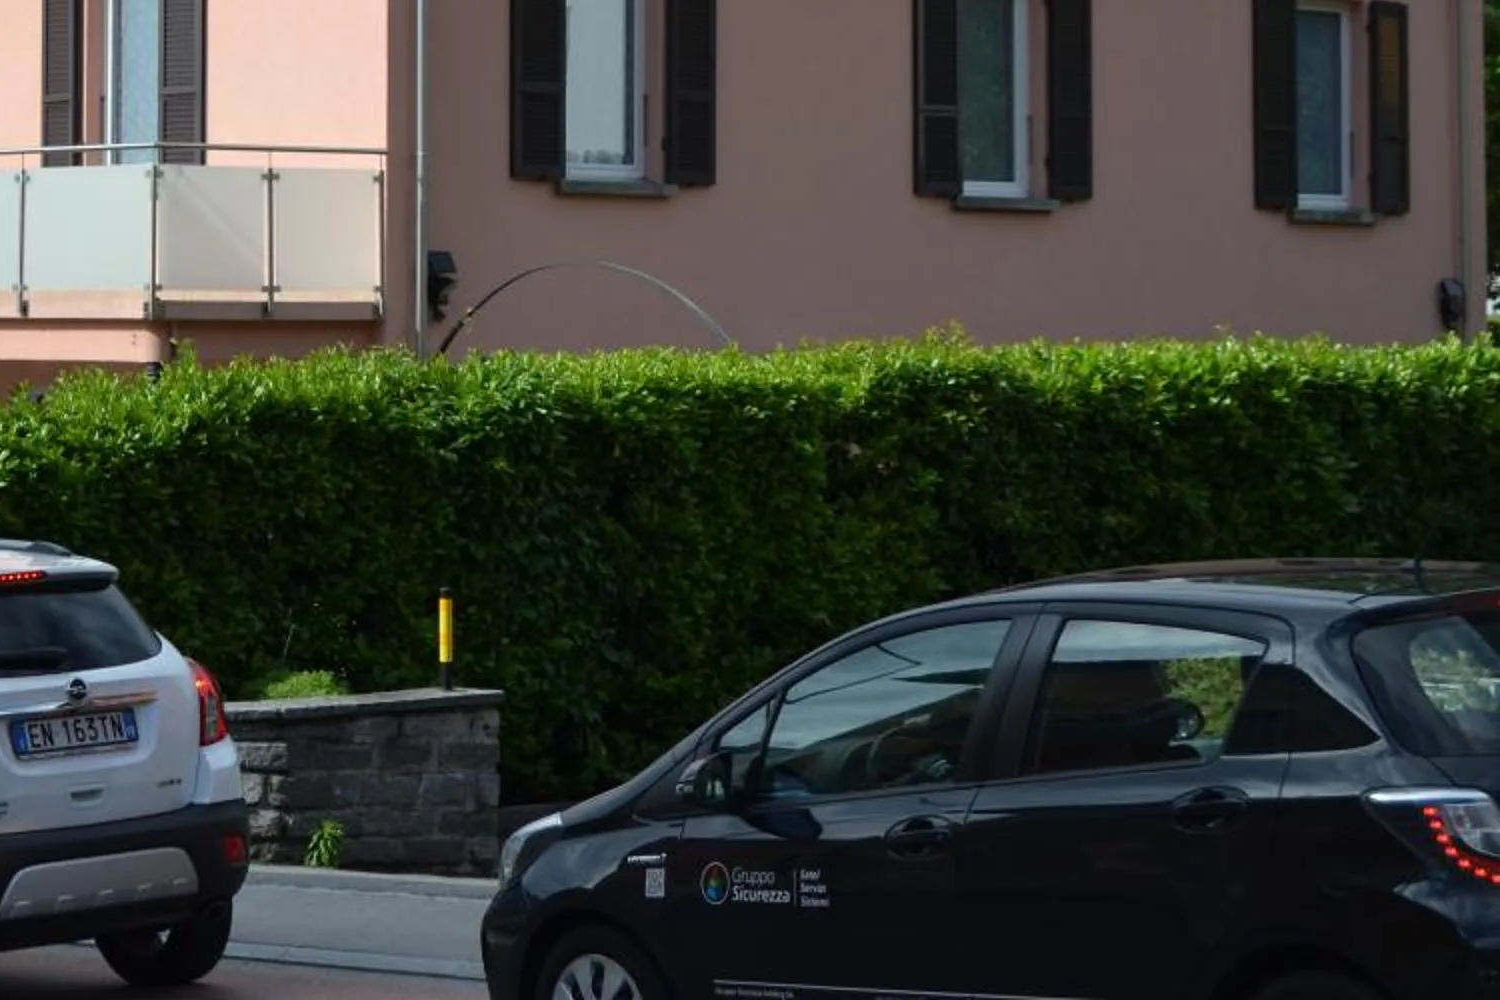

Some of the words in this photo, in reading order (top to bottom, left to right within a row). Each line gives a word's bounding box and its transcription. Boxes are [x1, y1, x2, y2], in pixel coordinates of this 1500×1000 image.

[28, 723, 54, 749] EN
[63, 713, 125, 744] 163TN
[731, 866, 776, 888] Gruppo
[731, 886, 791, 903] Sicurezza
